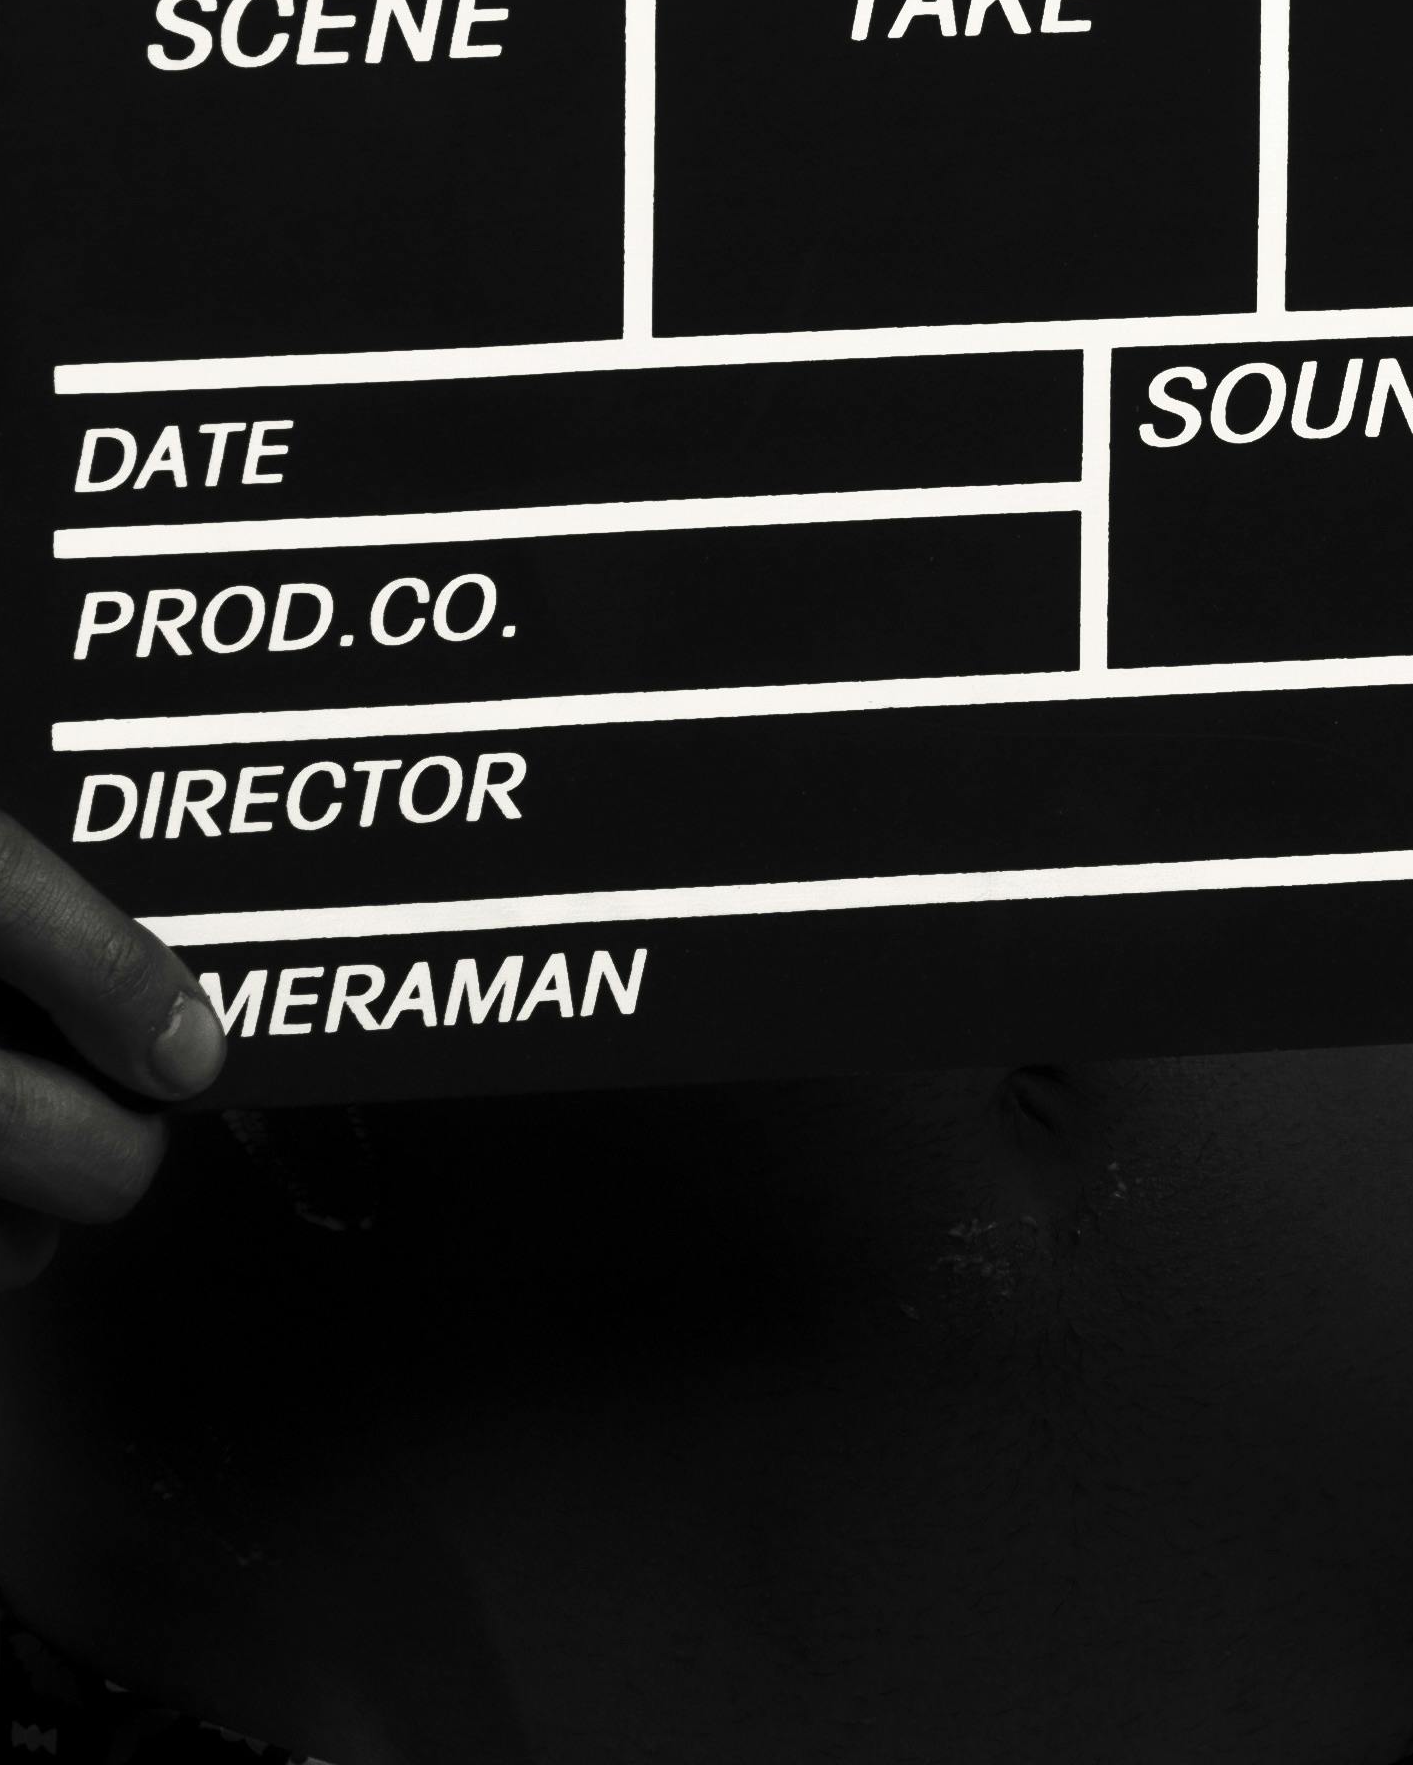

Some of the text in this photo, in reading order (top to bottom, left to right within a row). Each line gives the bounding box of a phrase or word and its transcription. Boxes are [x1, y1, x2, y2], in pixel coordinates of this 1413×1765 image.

[74, 419, 294, 493] DATE
[72, 752, 527, 843] DIRECTOR
[196, 948, 648, 1038] MERAMAN
